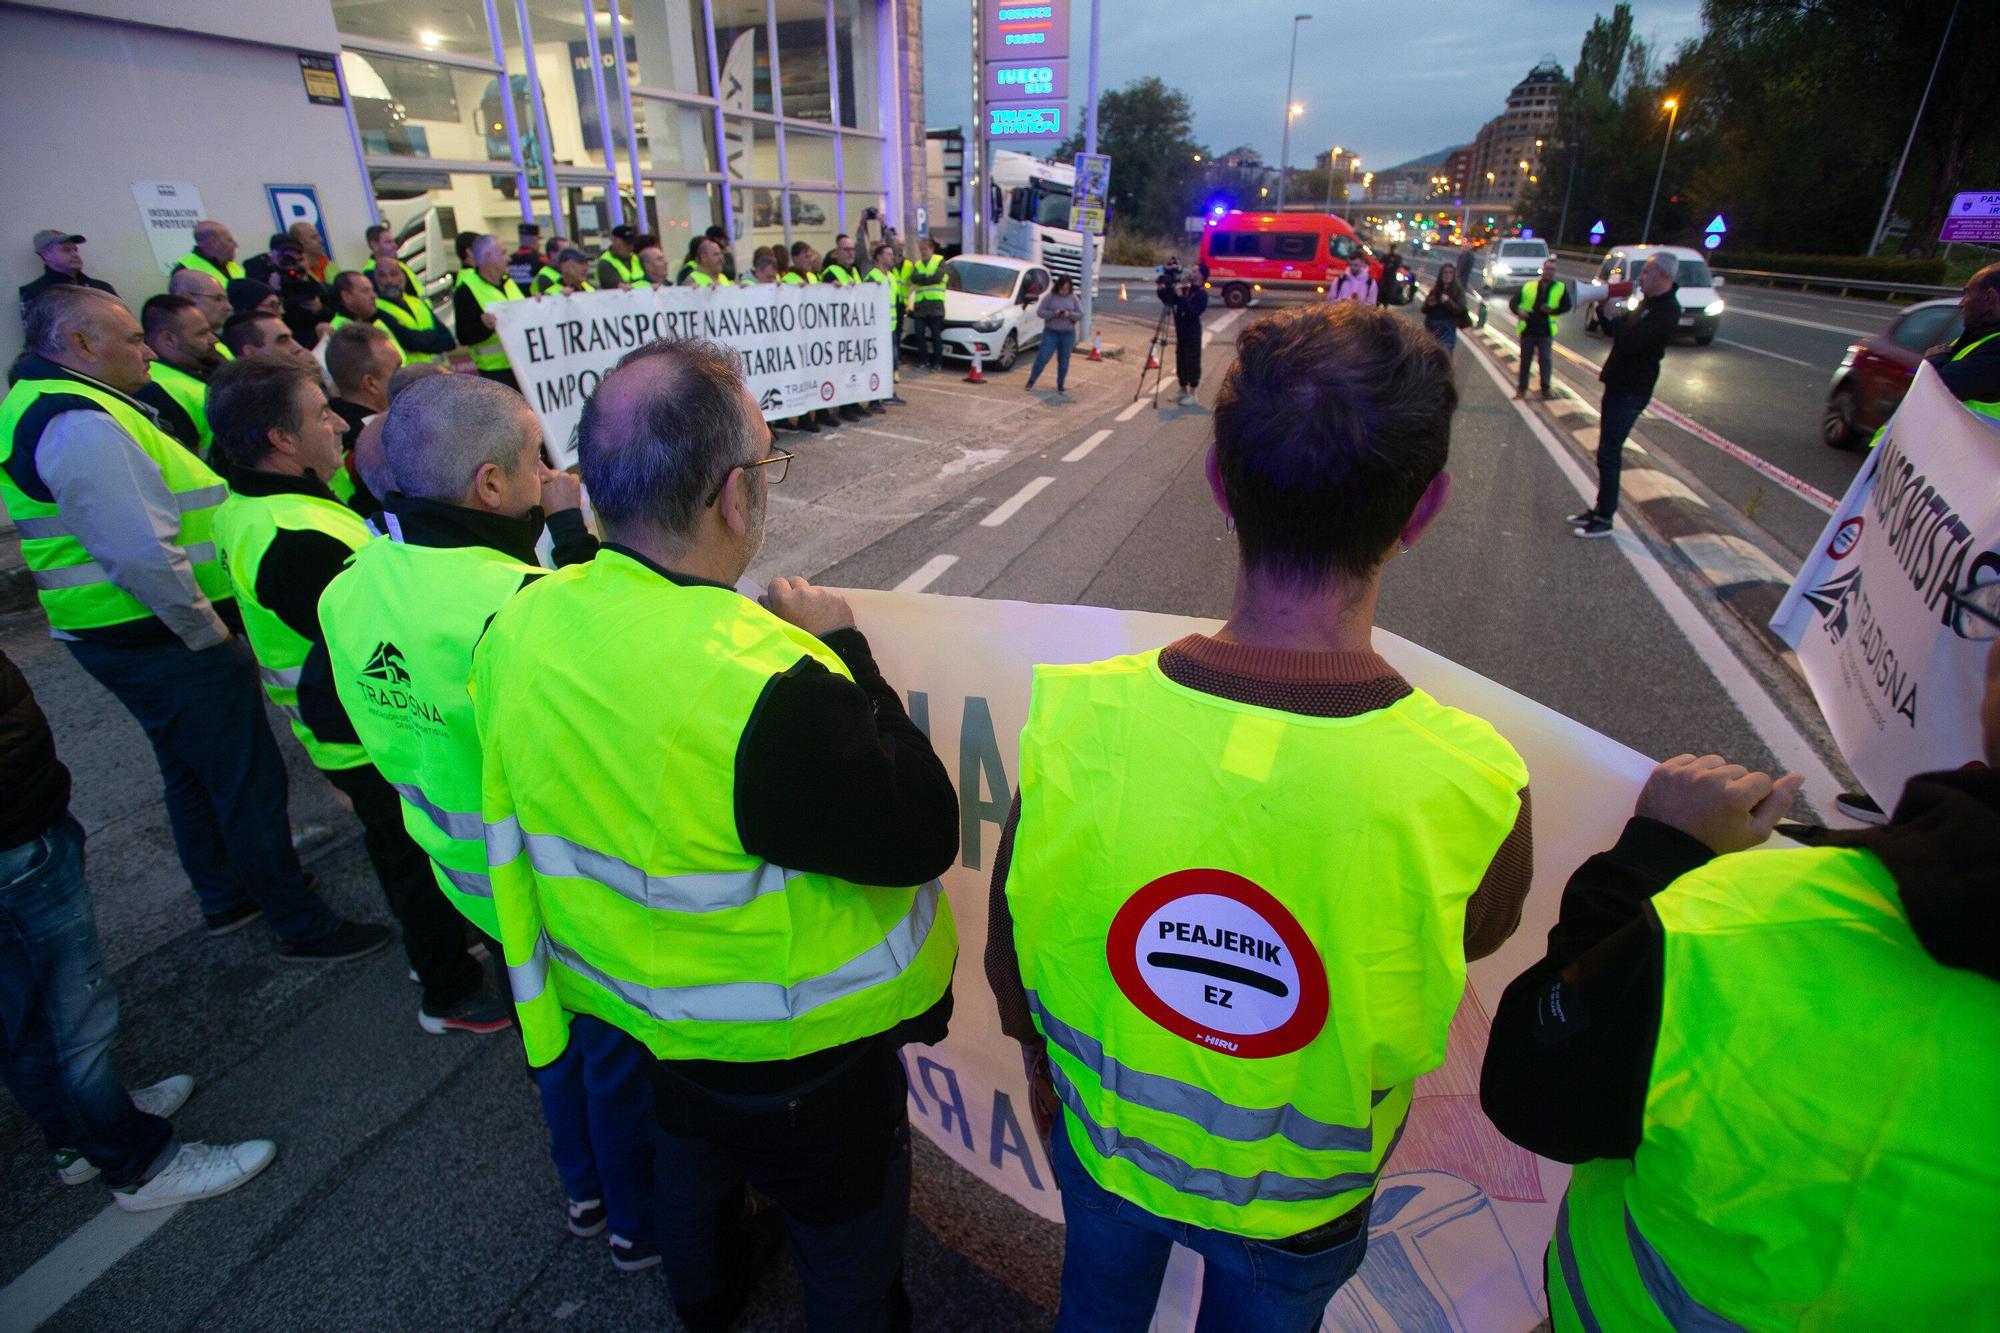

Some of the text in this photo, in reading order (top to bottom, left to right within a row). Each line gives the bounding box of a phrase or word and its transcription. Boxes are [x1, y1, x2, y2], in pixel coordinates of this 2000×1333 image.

[998, 67, 1053, 84] IVECO
[991, 109, 1043, 123] TRUCK
[991, 120, 1059, 135] STATION
[525, 302, 876, 363] EL TRANSPORTE NAVARRO CONTRA LA
[537, 369, 599, 414] IMPO
[742, 346, 796, 377] TARIA
[838, 338, 877, 366] PEAJES
[1159, 921, 1282, 967] PEAJERIK
[1204, 985, 1233, 1009] EZ
[1204, 1035, 1239, 1052] HIRU
